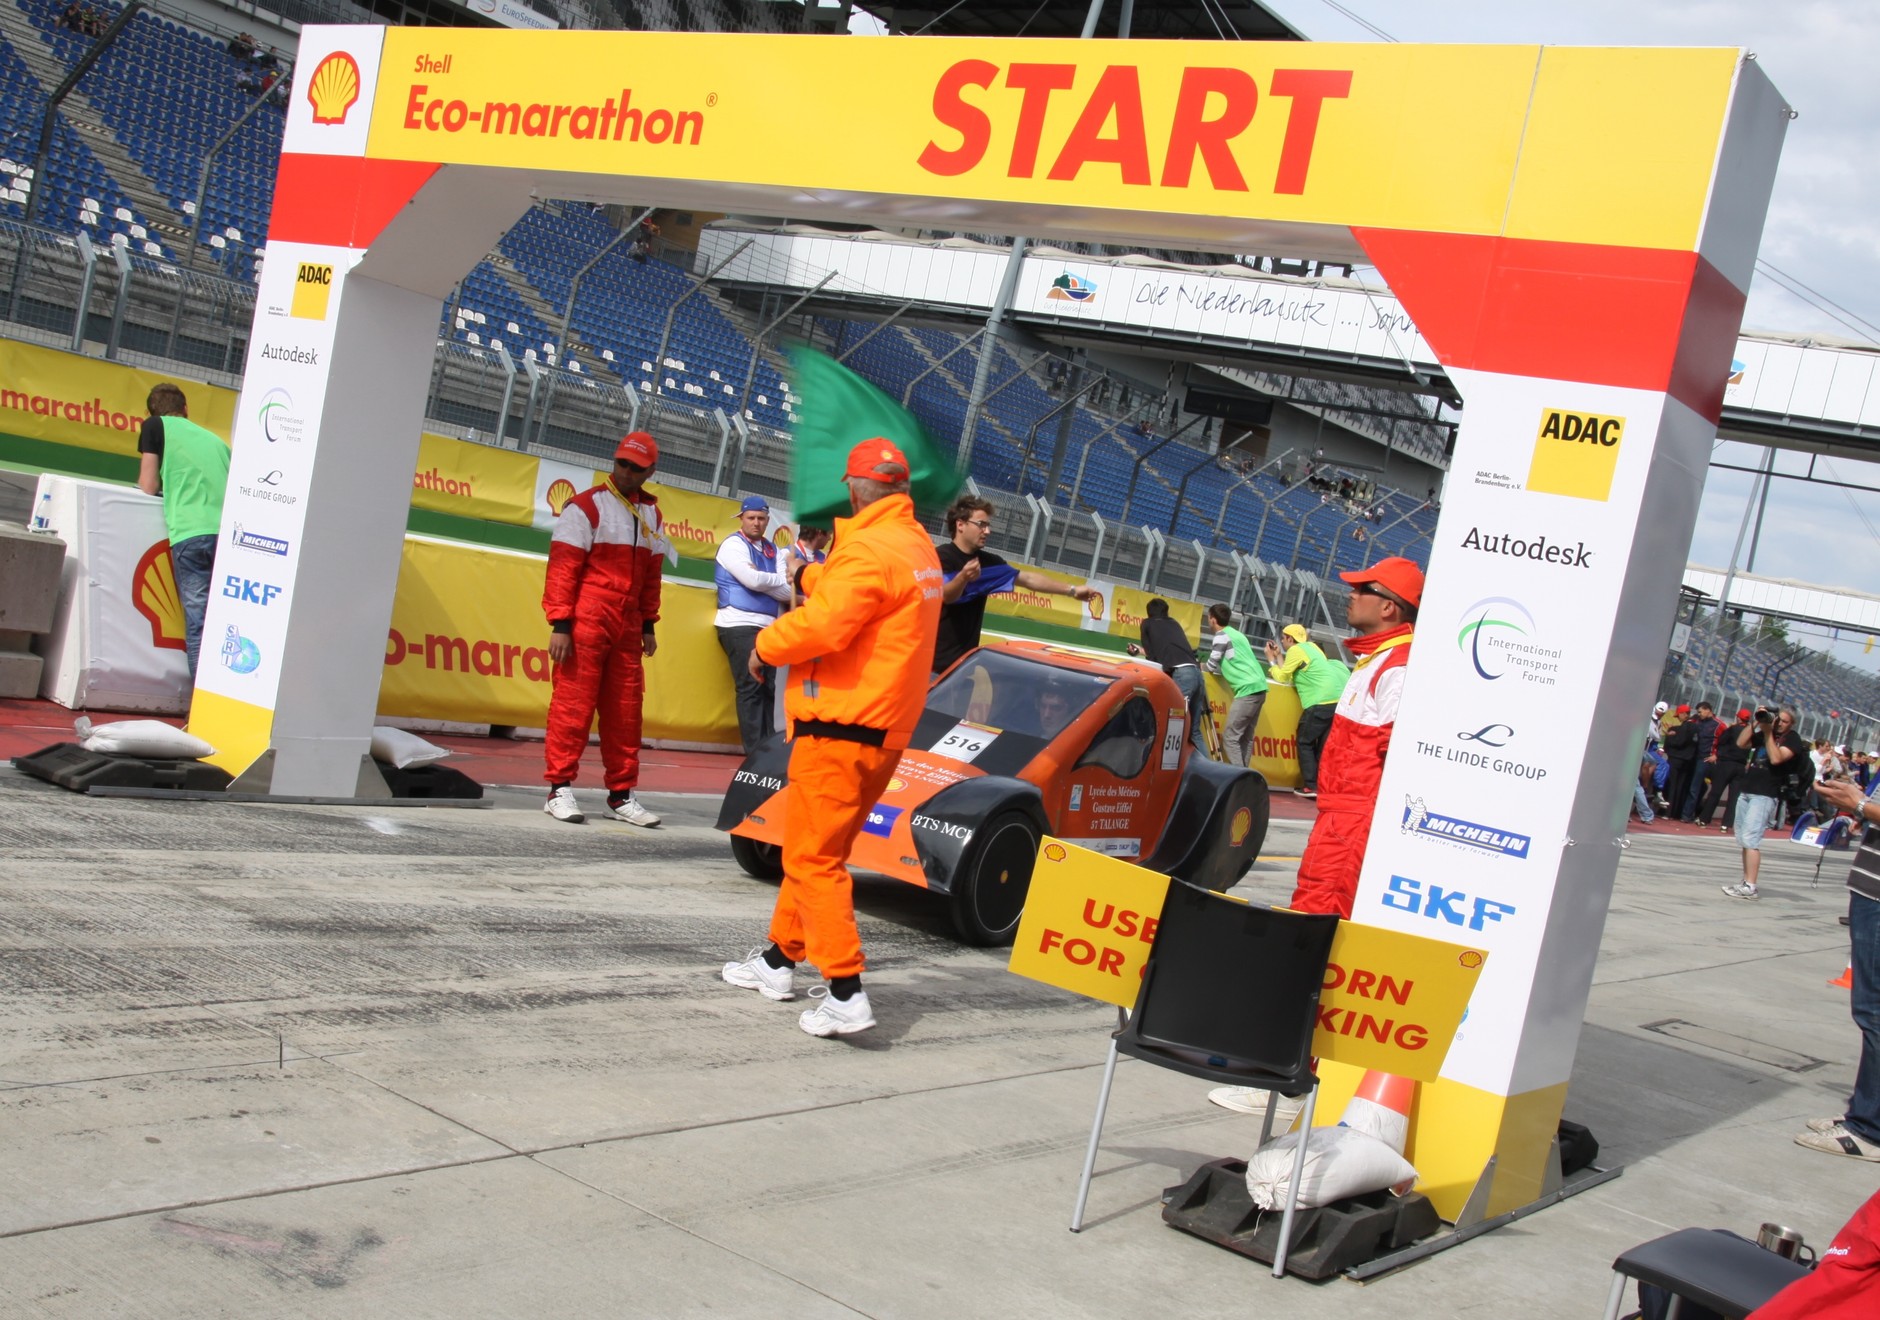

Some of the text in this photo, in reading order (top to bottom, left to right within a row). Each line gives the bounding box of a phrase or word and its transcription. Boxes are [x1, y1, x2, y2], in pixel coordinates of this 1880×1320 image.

[414, 54, 453, 74] Shell
[916, 58, 1354, 195] START
[297, 264, 332, 286] ADAC
[1136, 280, 1169, 306] Die
[1177, 282, 1328, 327] Niederlausitz
[261, 343, 318, 365] Autodesk
[1, 389, 145, 433] marathon
[286, 434, 302, 443] Forum
[1541, 412, 1620, 447] ADAC
[1475, 478, 1510, 489] Brandenburg
[1476, 471, 1492, 479] ADAC
[239, 486, 297, 505] THE LINDE GROUP
[242, 534, 288, 552] MICHELIN
[1461, 527, 1593, 568] Autodesk
[222, 575, 282, 607] SKF
[1488, 636, 1562, 659] International
[1506, 653, 1558, 673] Transport
[1522, 670, 1556, 686] Forum
[944, 735, 982, 752] 516
[1165, 734, 1181, 751] 516
[1416, 741, 1547, 781] THE LINDE GROUP
[734, 770, 781, 791] BTS AVA
[1107, 785, 1117, 797] des
[1092, 802, 1133, 813] Gustave Eiffel
[911, 814, 940, 831] BTS
[1090, 818, 1130, 830] 57 TALANGE
[1426, 817, 1527, 851] MICHELIN
[1381, 874, 1516, 932] SKF
[1082, 898, 1160, 944] USE
[1039, 928, 1126, 977] FOR
[1314, 1004, 1429, 1050] KING
